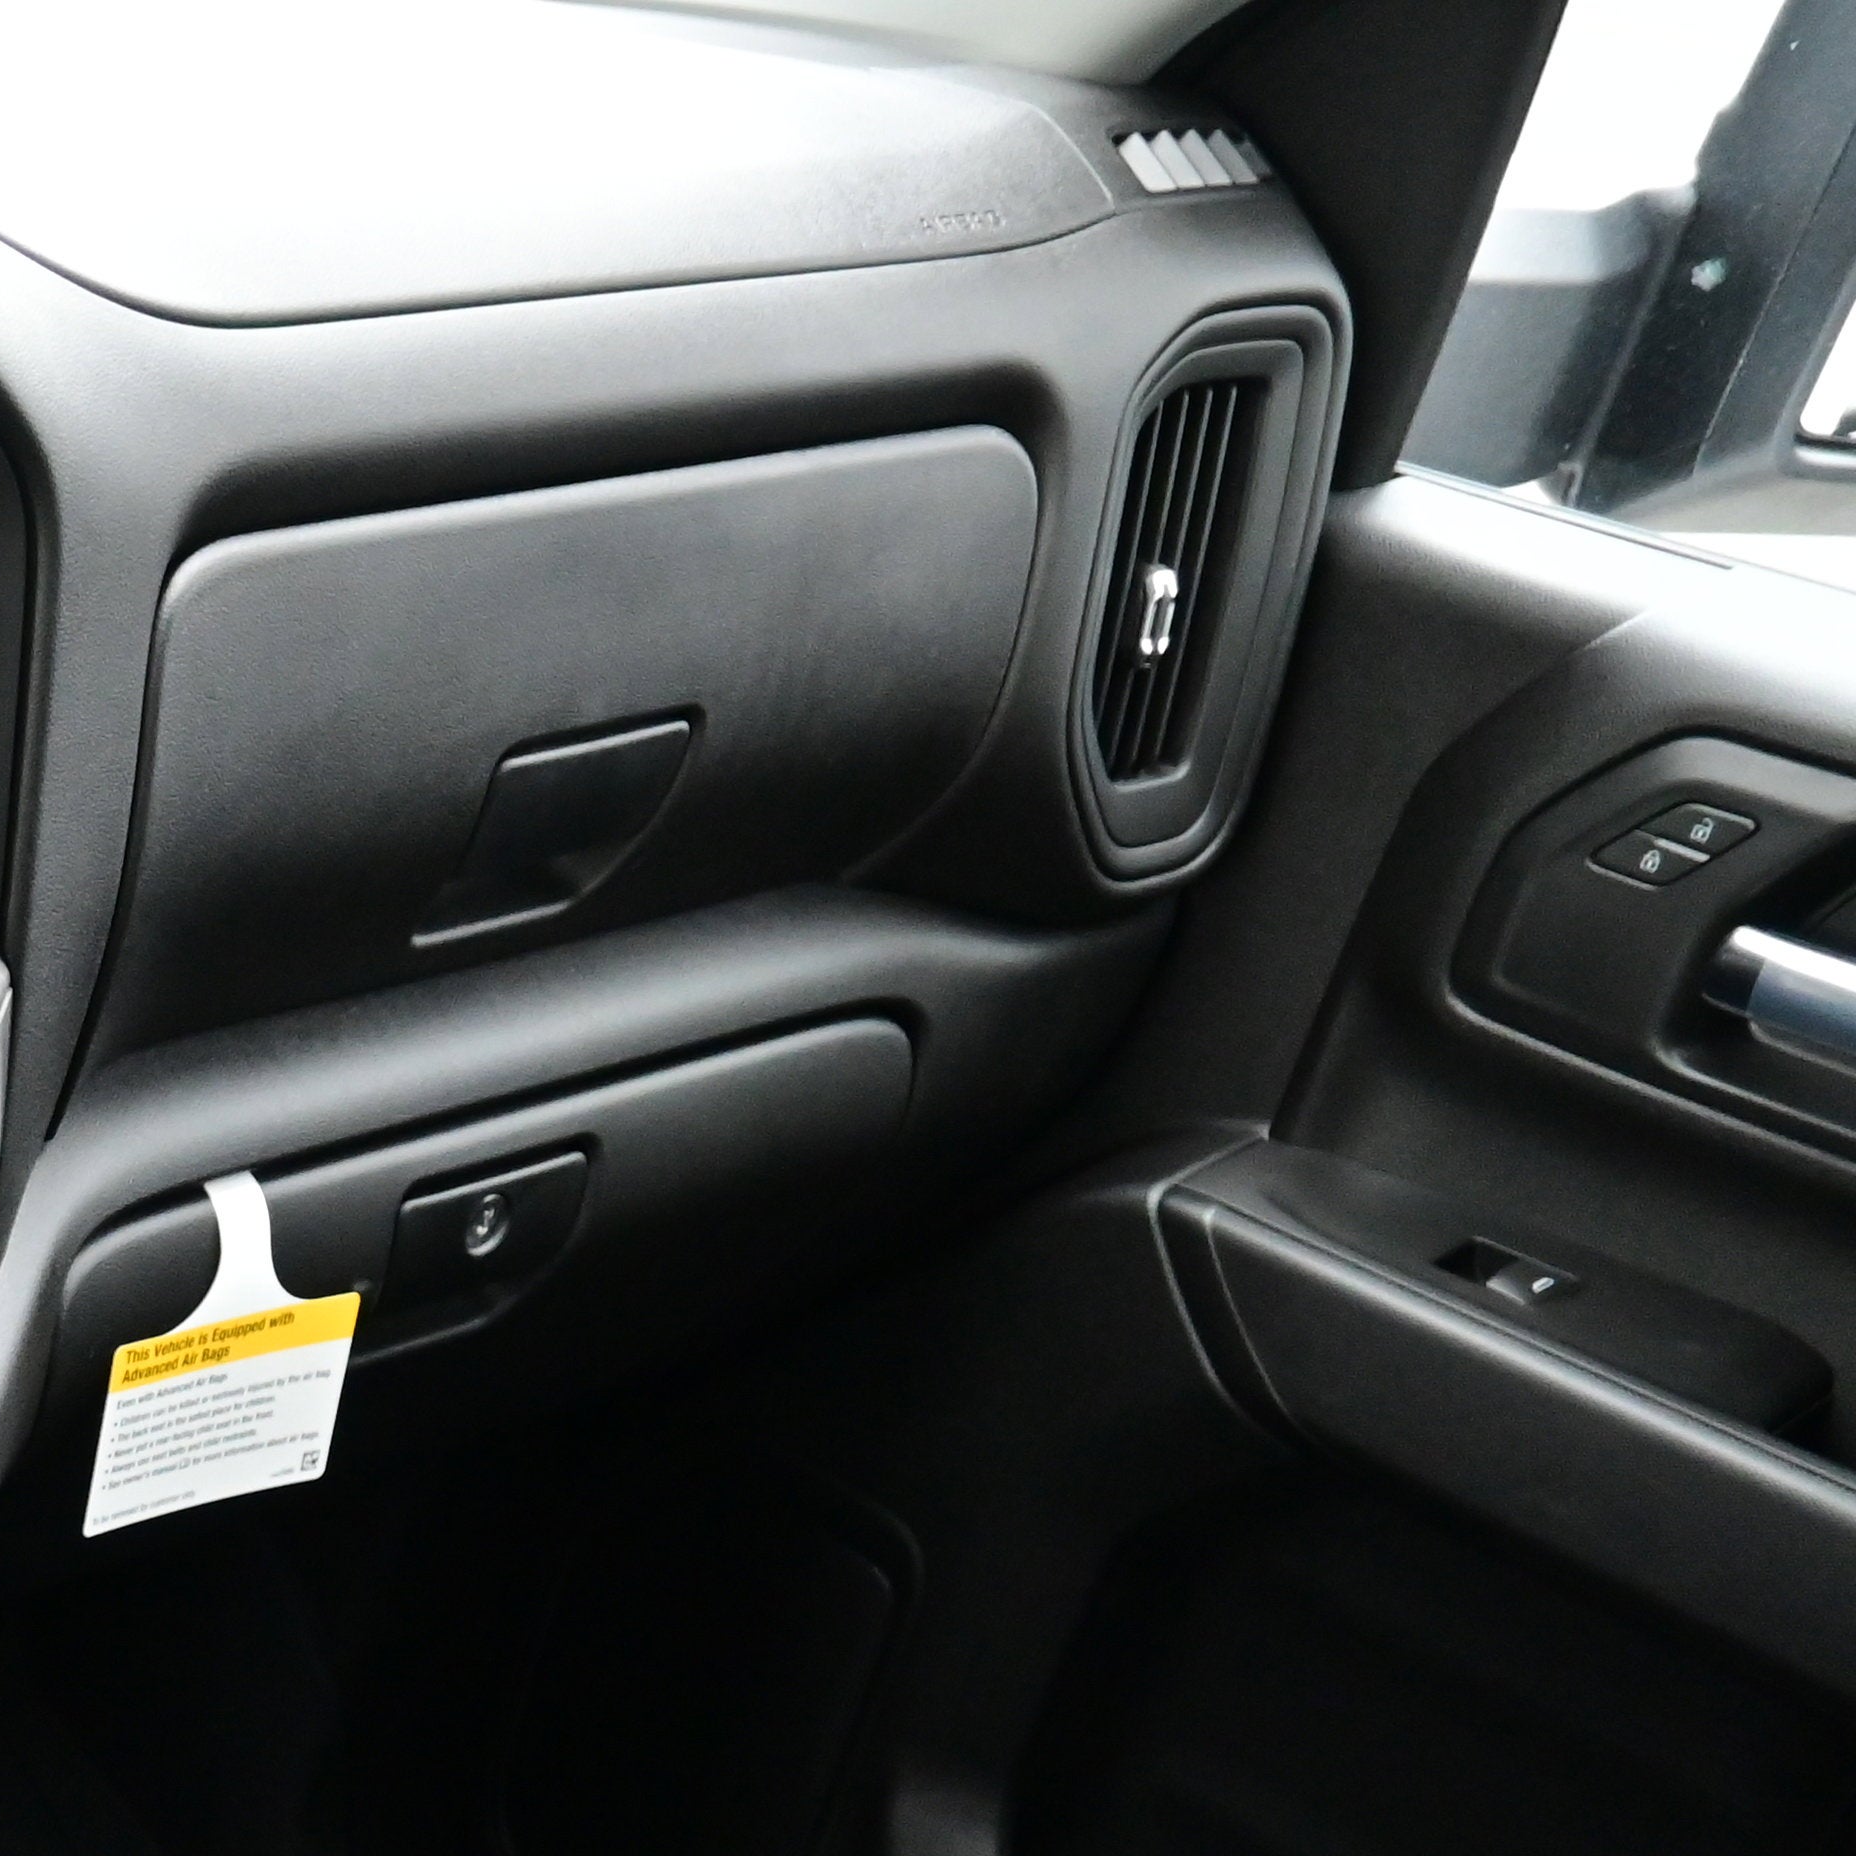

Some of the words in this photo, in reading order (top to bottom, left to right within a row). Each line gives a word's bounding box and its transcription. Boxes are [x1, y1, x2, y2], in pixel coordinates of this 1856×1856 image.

[126, 1348, 150, 1364] This
[155, 1336, 195, 1357] Vehicle
[198, 1332, 208, 1345] is
[212, 1317, 265, 1342] Equipped
[269, 1312, 295, 1329] with
[122, 1358, 178, 1384] Advanced
[181, 1351, 199, 1366] Air
[201, 1345, 230, 1363] Bags
